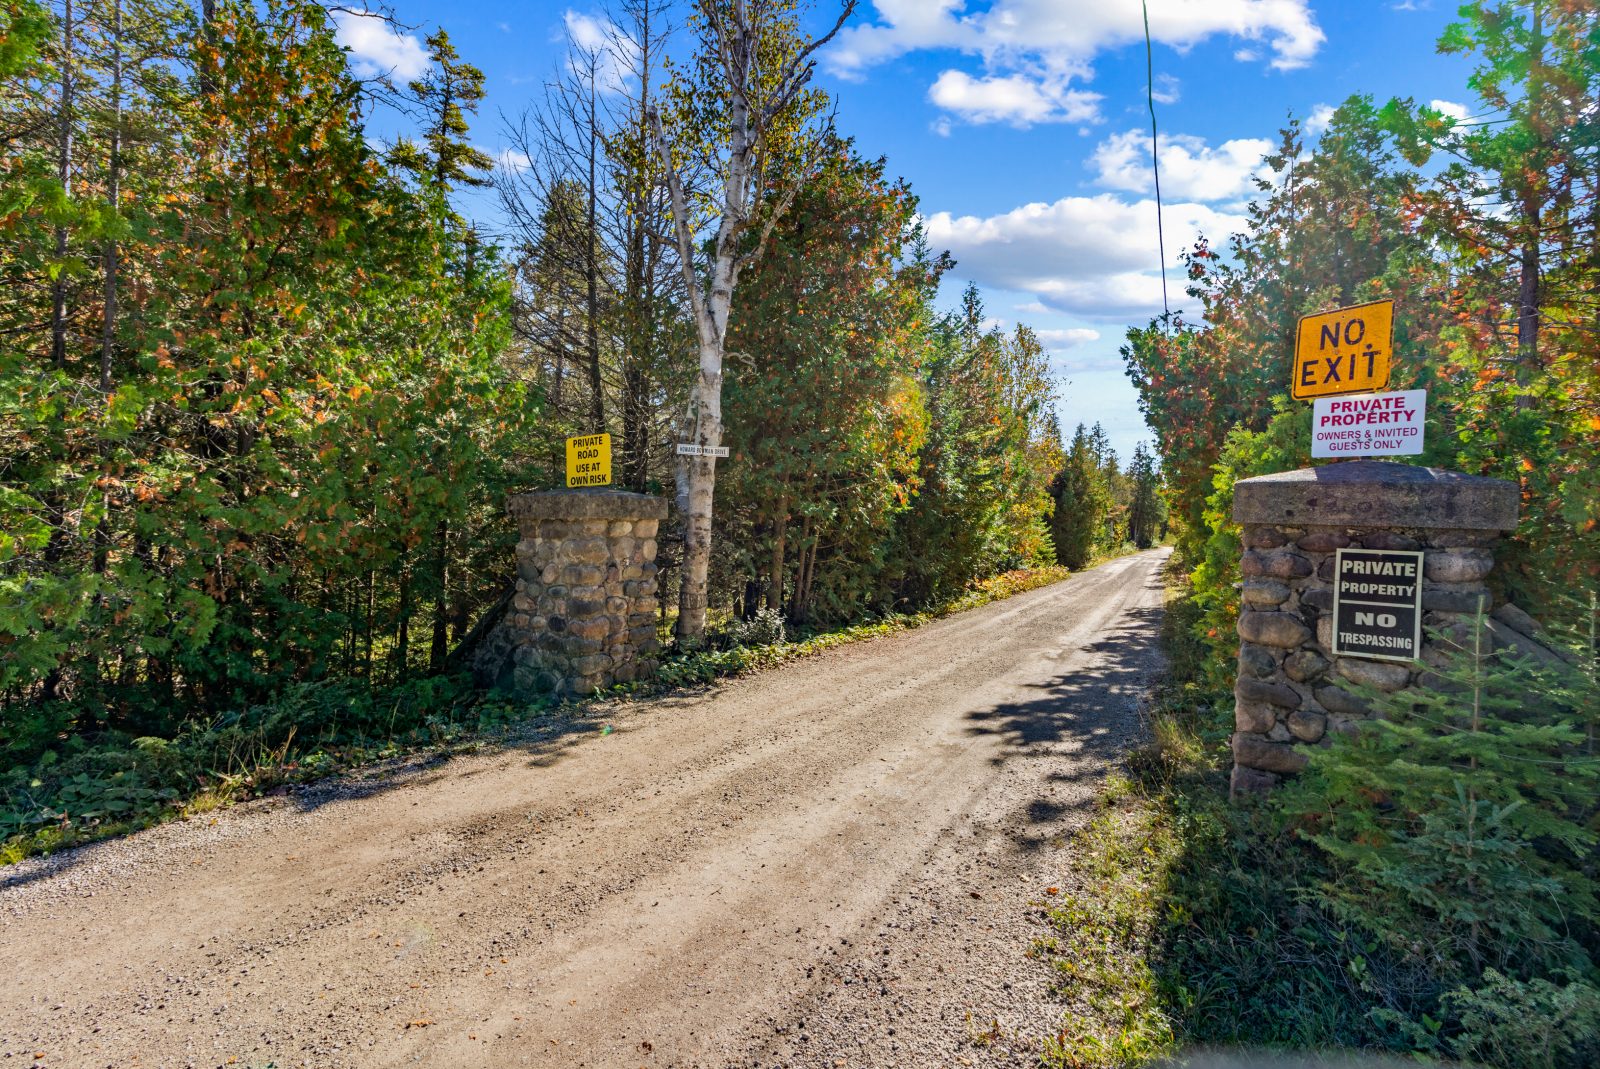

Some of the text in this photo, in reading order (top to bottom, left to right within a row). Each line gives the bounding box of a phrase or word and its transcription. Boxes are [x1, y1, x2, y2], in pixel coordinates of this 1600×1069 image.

[1319, 318, 1366, 350] NO
[1301, 350, 1381, 387] EXIT
[1330, 396, 1406, 413] PRIVATE
[1320, 409, 1416, 427] PROPERTY
[573, 436, 603, 448] PRIVATE
[1316, 427, 1418, 441] OWNERS & INVITED
[1329, 439, 1403, 451] GUESTS ONLY
[577, 449, 599, 460] ROAD
[576, 462, 601, 473] USE AT
[570, 473, 607, 486] OWN RISK
[1341, 559, 1416, 577] PRIVATE
[1341, 580, 1415, 597] PROPERTY
[1354, 611, 1397, 628] NO
[1339, 631, 1413, 650] TRESPASSING
